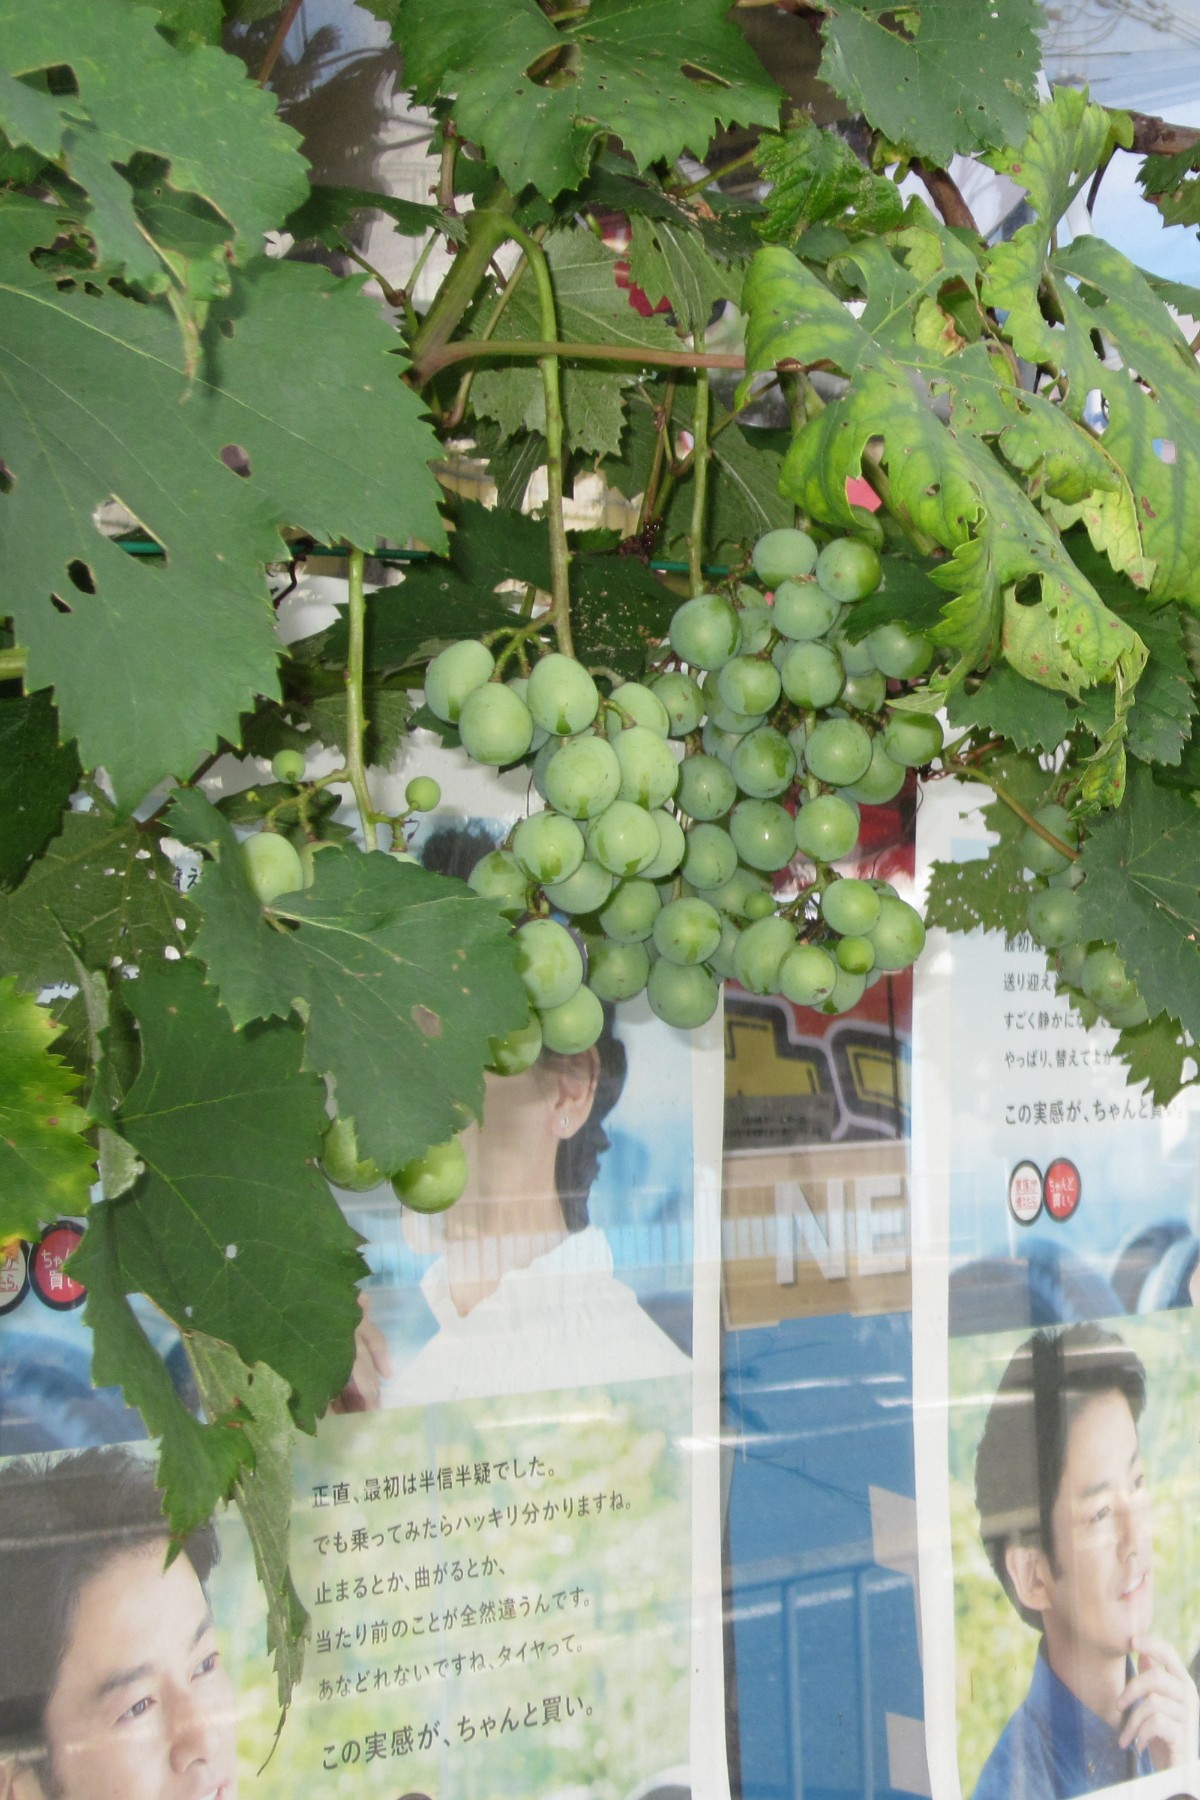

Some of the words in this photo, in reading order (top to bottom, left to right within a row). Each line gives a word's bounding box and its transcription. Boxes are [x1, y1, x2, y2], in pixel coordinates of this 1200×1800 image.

[312, 1455, 555, 1509] 正直、最初は半信半疑でした。
[313, 1489, 632, 1556] でも乗ってみたらハッキリ分かりますね。
[315, 1554, 506, 1606] 止まるとか、曲がるとか、
[316, 1585, 590, 1654] 当たり前のことが全然違うんです。
[318, 1633, 584, 1701] あなどれないですね、タイヤって。
[322, 1695, 593, 1771] この実感が、ちゃんと買い。
